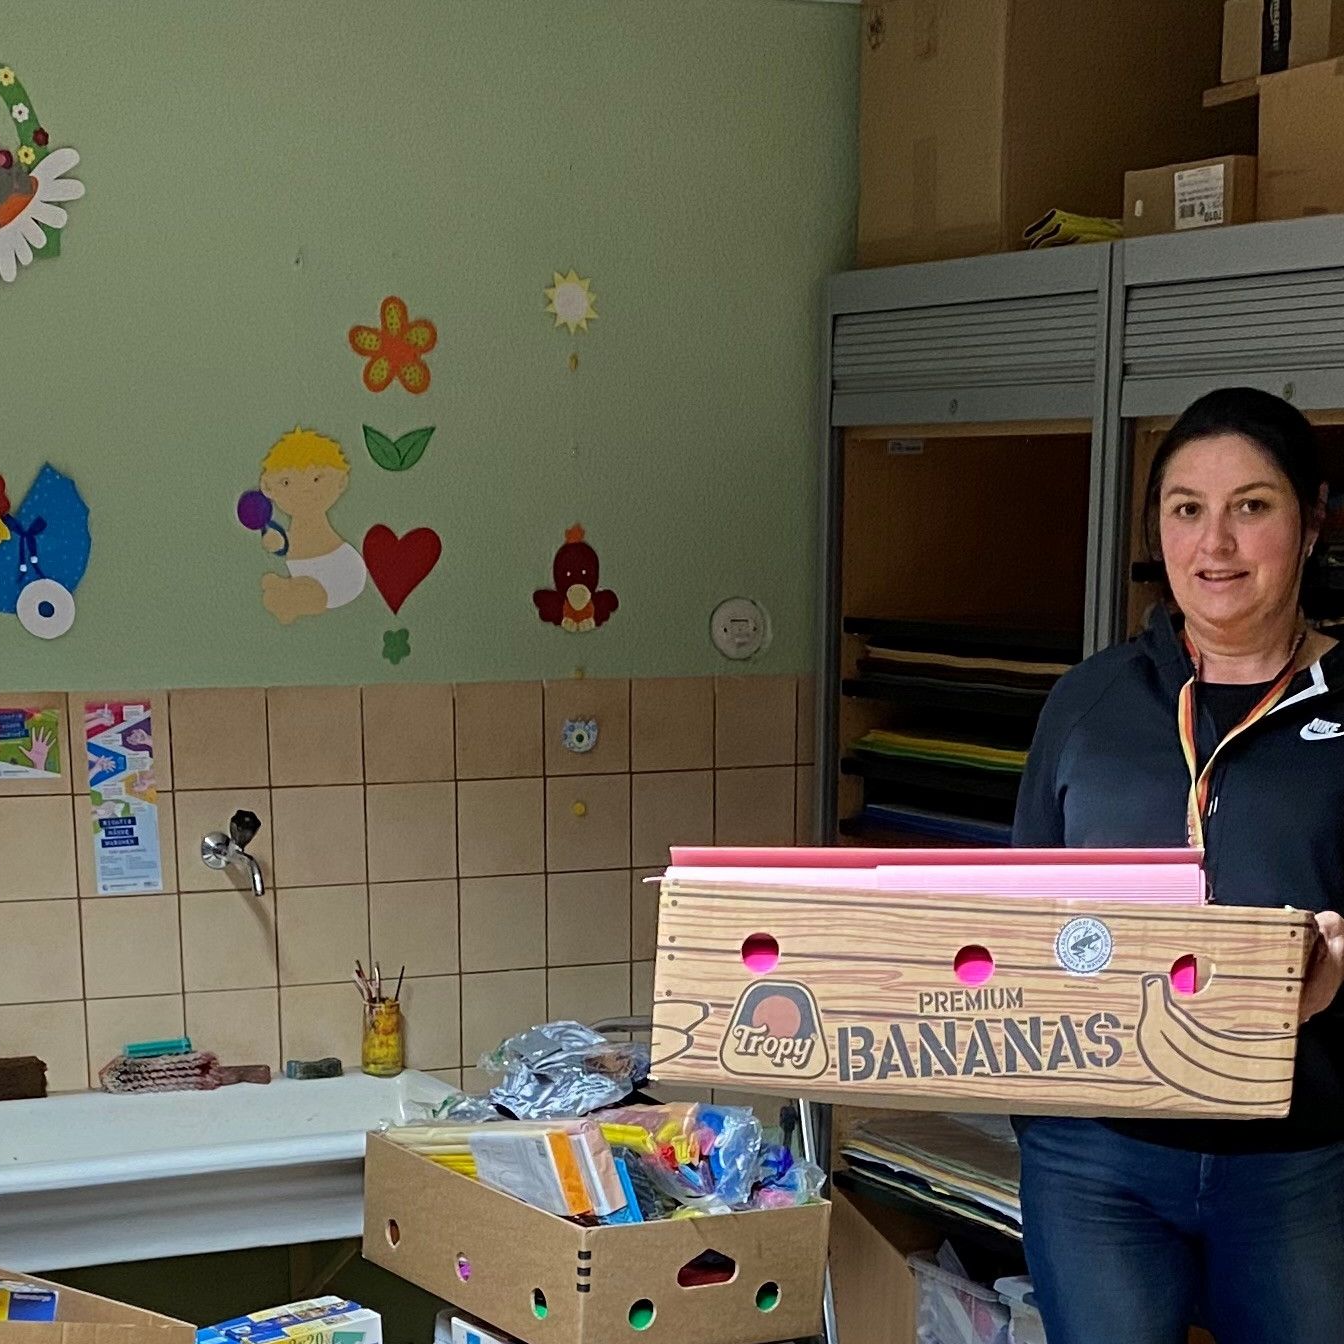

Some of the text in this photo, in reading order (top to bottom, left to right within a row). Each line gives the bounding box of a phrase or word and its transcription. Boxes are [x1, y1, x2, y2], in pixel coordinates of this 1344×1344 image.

[1308, 717, 1342, 735] NIKE
[918, 986, 1025, 1014] PREMIUM
[732, 1022, 816, 1071] Tropy
[836, 1011, 1125, 1083] BANANAS
